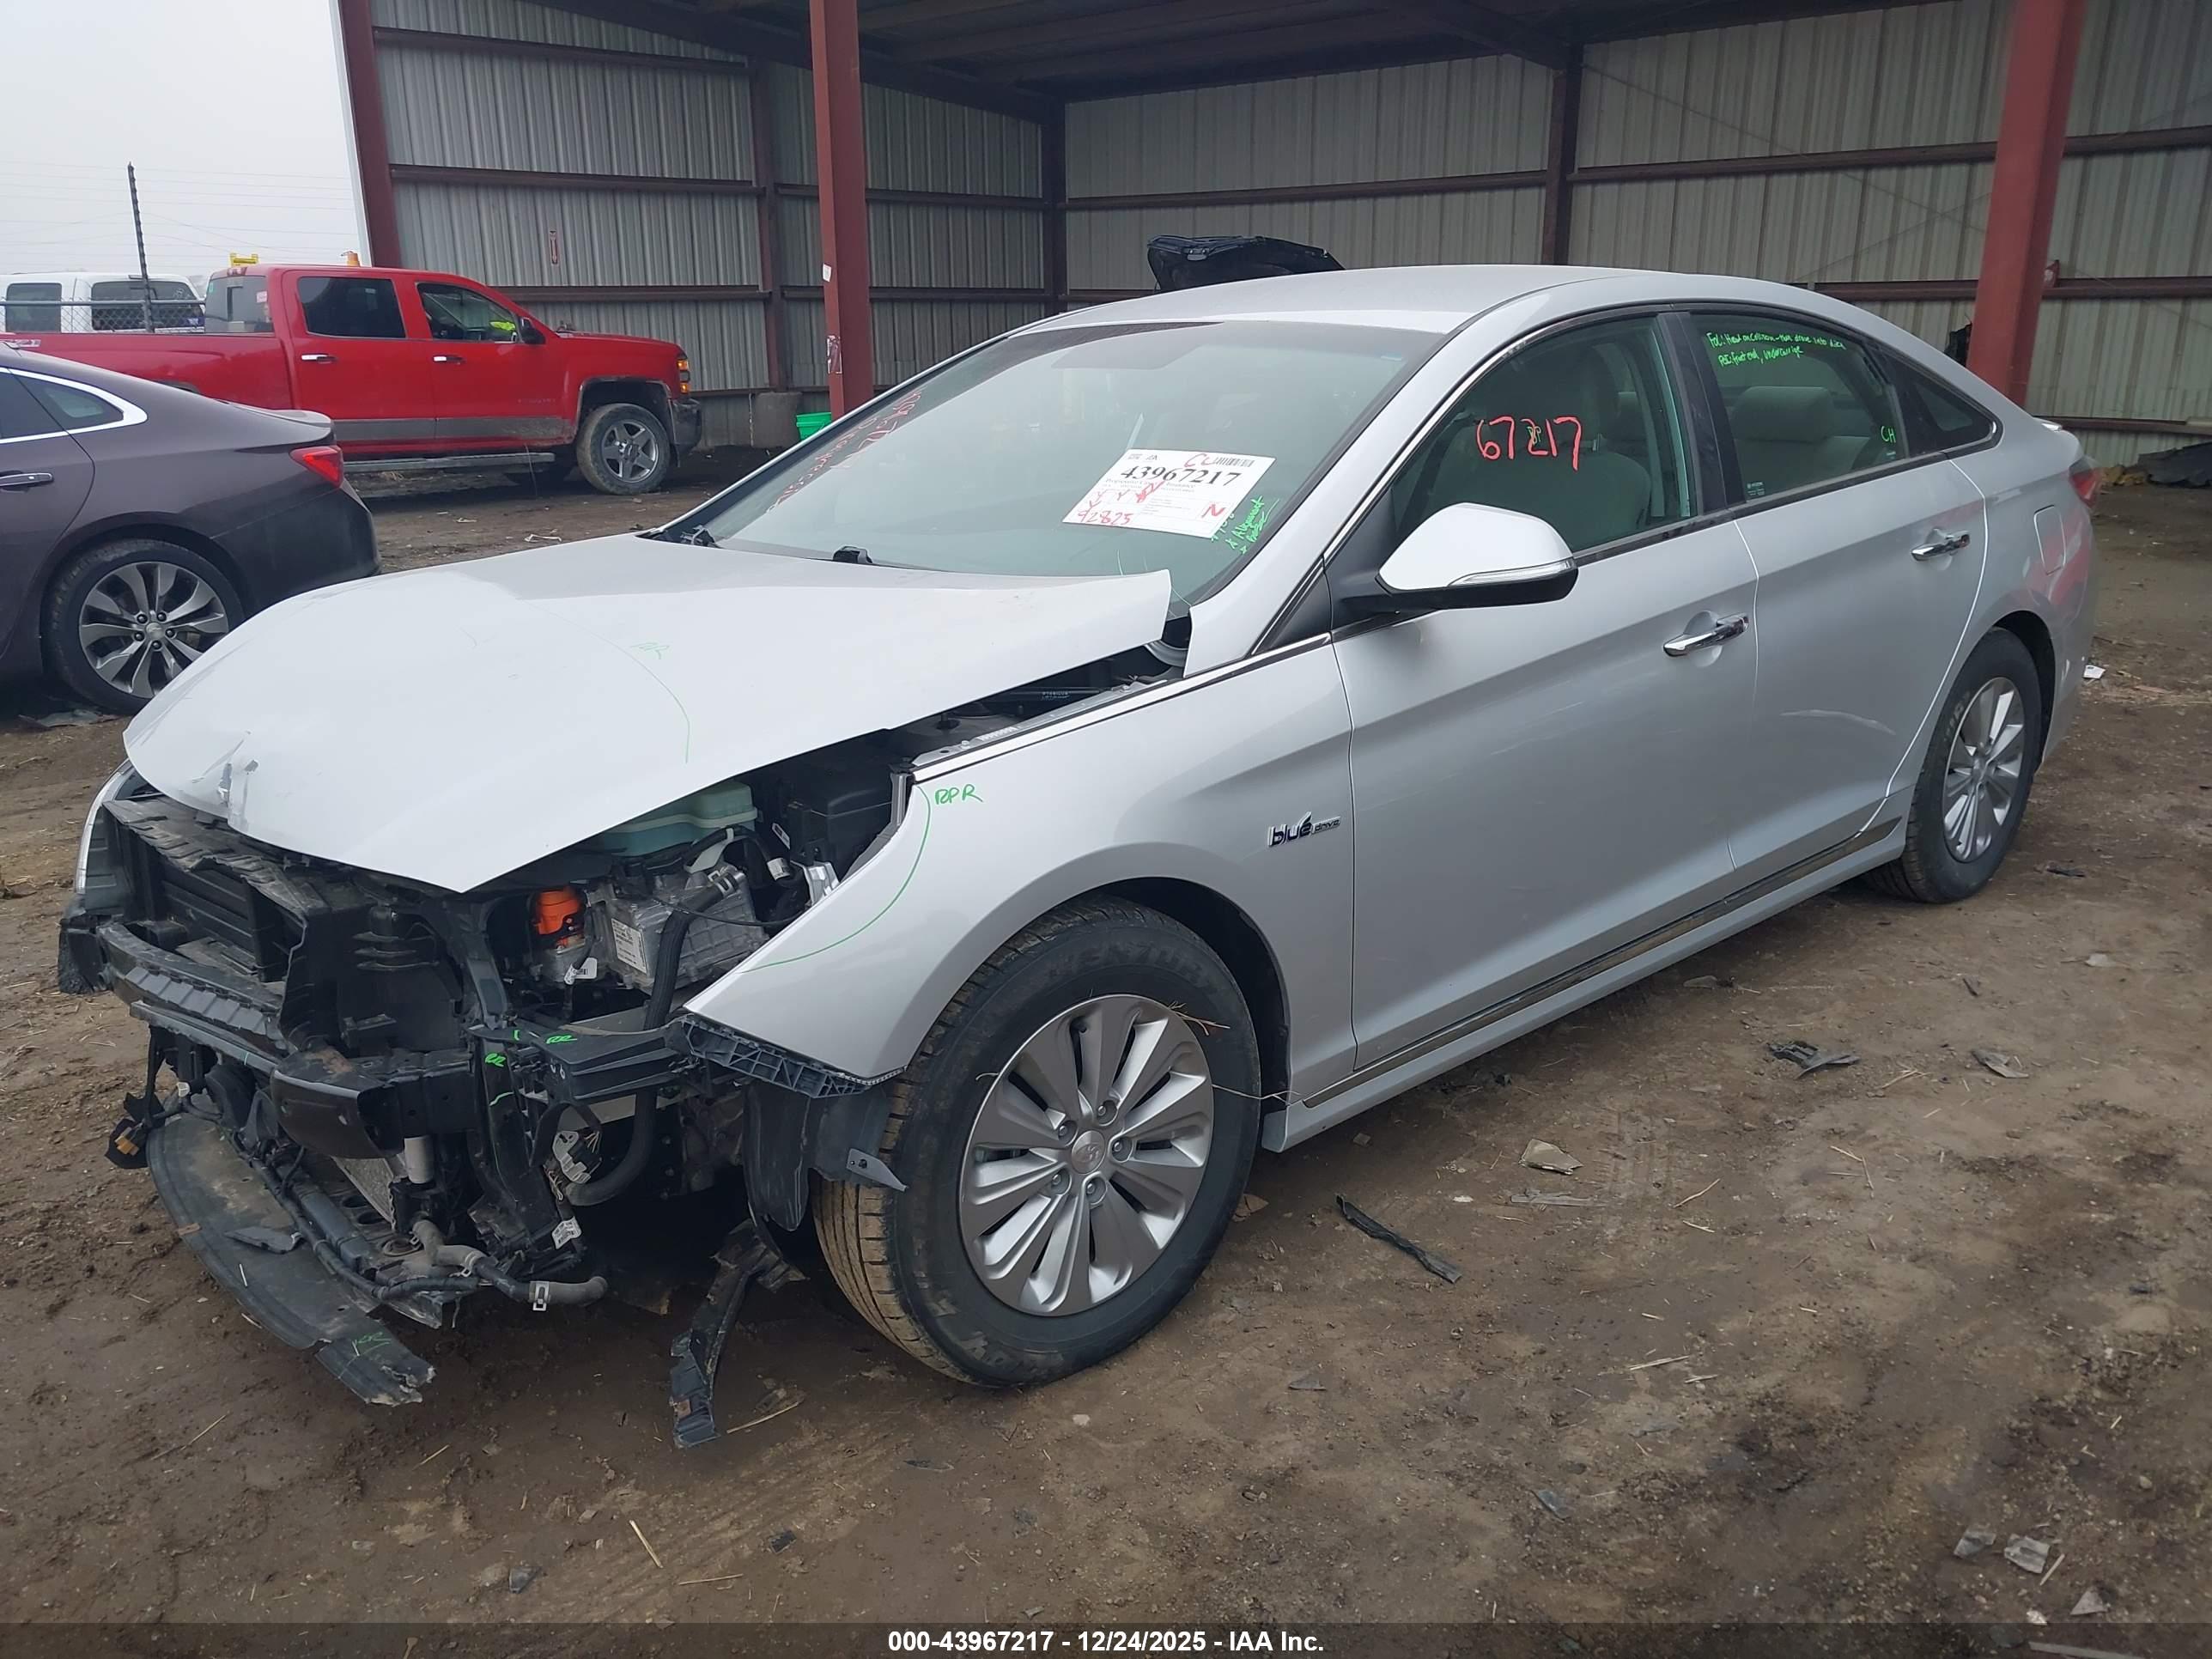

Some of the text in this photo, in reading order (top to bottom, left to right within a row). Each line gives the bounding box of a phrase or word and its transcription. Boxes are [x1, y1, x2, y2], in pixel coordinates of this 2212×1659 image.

[1476, 416, 1582, 471] 67217
[1881, 426, 1896, 443] CH
[1121, 465, 1242, 487] 43967217
